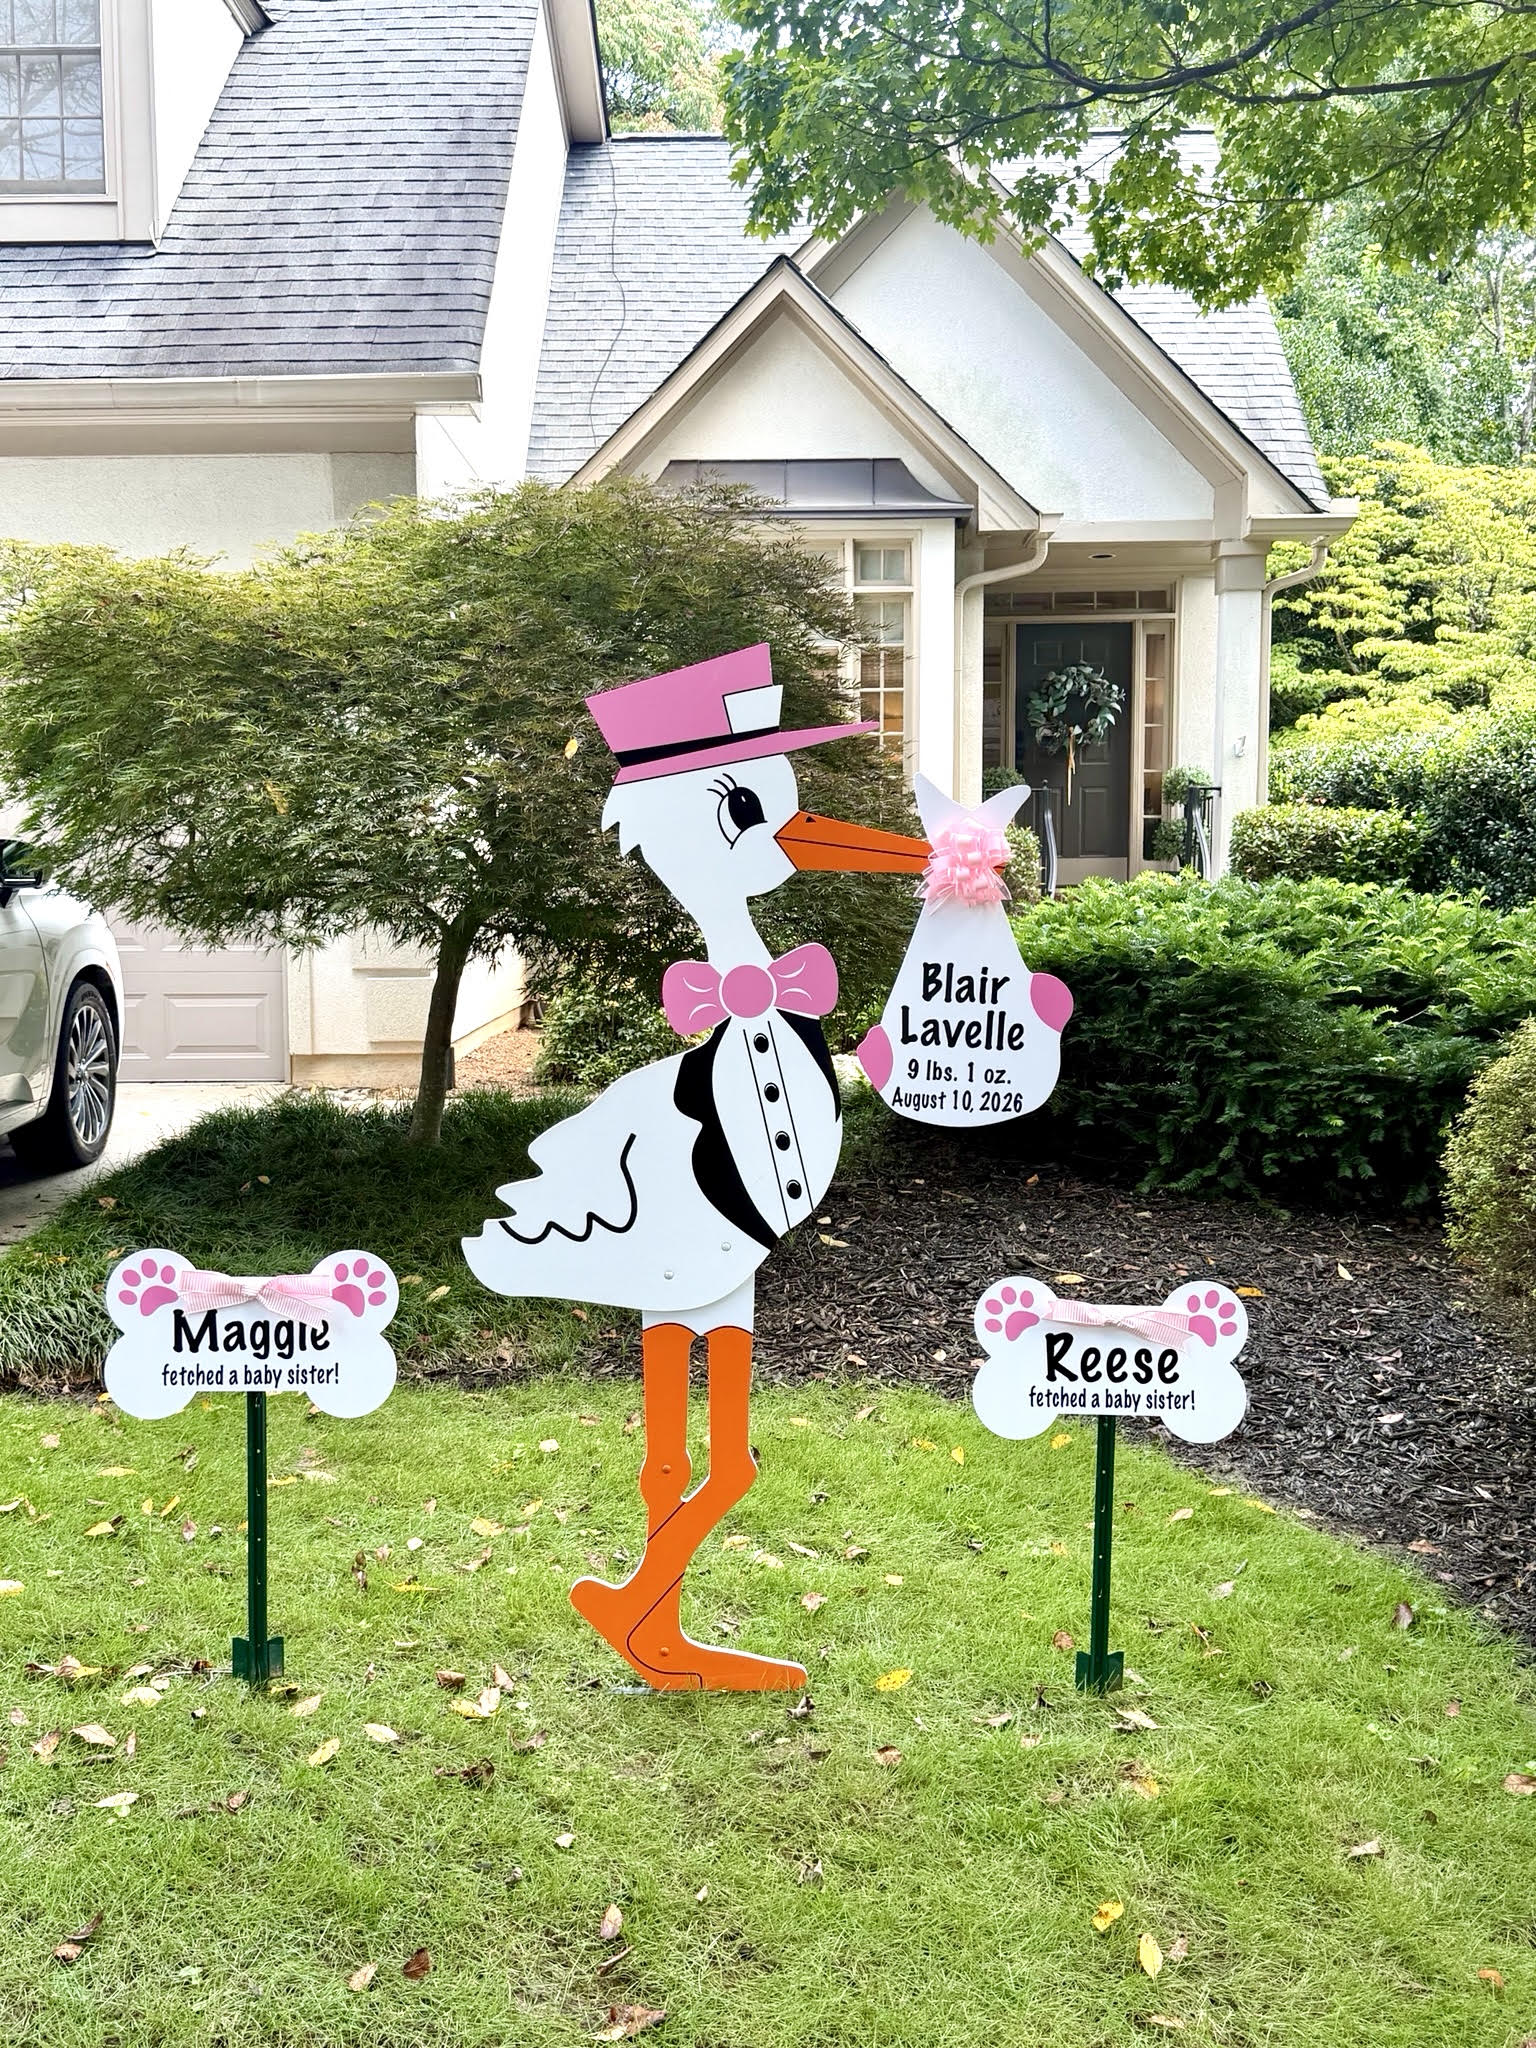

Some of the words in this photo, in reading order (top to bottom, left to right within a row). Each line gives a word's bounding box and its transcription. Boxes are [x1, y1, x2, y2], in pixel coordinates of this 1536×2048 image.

[921, 961, 1011, 1005] Blair
[900, 1005, 1025, 1052] Lavelle
[907, 1058, 920, 1080] 9
[926, 1060, 958, 1083] lbs.
[967, 1061, 975, 1083] 1
[984, 1068, 1012, 1085] oz.
[891, 1086, 947, 1112] August
[952, 1089, 975, 1113] 10,
[979, 1090, 1024, 1114] 2026
[1044, 1331, 1180, 1385] Reese
[161, 1363, 224, 1387] fetched
[228, 1369, 239, 1386] a
[243, 1364, 283, 1389] baby
[287, 1362, 340, 1386] sister!
[1028, 1385, 1087, 1409] fetched
[1091, 1393, 1100, 1409] a
[1105, 1388, 1142, 1413] baby
[1146, 1389, 1196, 1412] sister!
